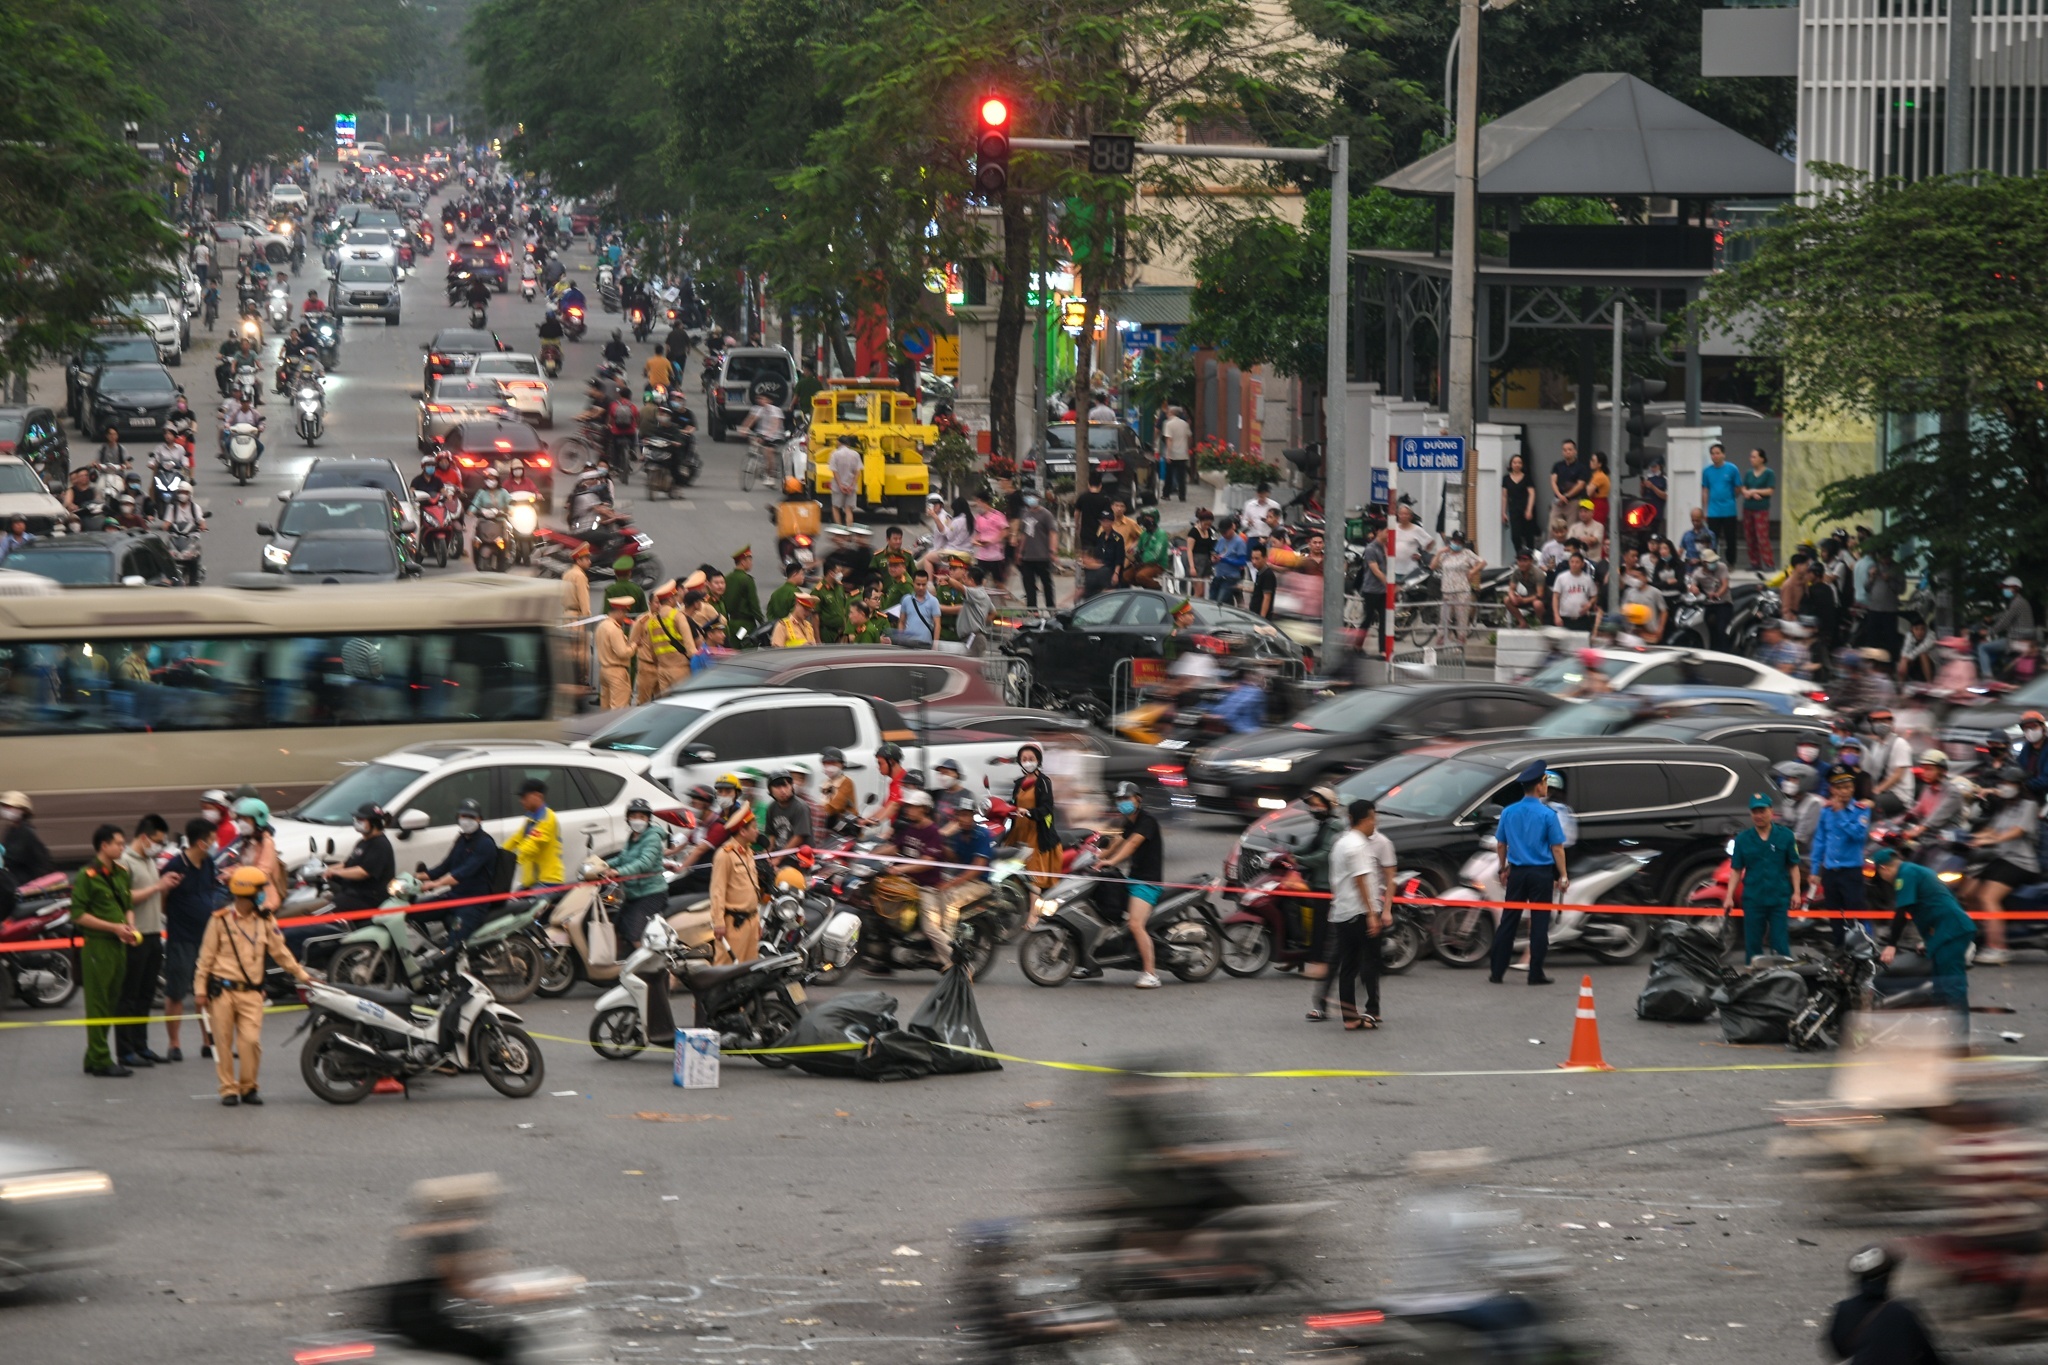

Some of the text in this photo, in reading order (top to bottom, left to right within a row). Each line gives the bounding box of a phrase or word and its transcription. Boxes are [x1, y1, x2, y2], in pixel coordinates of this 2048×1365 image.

[1423, 439, 1458, 450] ĐƯỜNG
[1419, 452, 1434, 468] CHÍ
[1435, 452, 1459, 468] CÔNG
